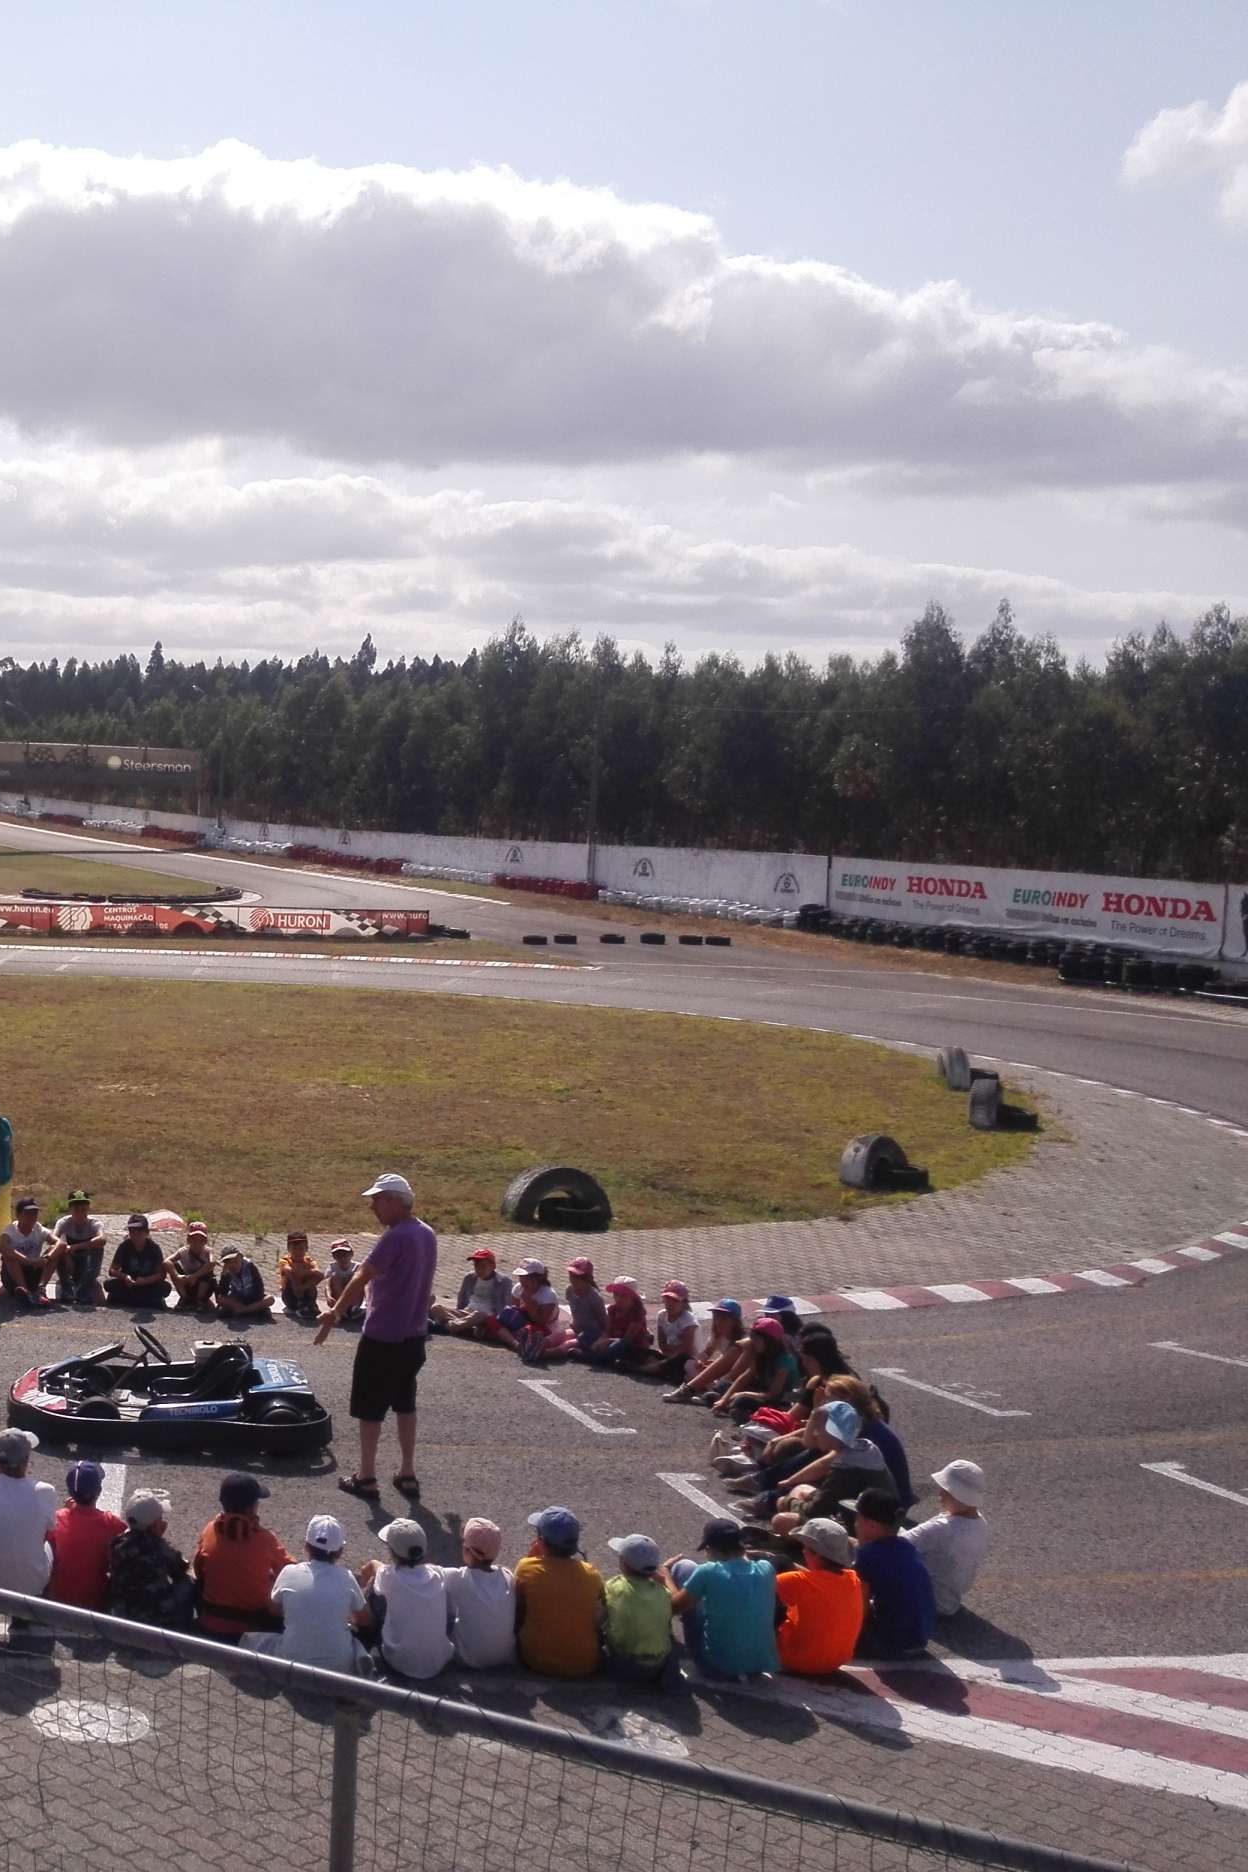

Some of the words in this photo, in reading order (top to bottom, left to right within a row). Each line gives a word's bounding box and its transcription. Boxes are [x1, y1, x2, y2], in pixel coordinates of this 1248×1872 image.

[123, 759, 192, 773] Steersman
[840, 873, 897, 891] EUROINDY
[906, 876, 988, 900] HONDA
[1012, 888, 1090, 909] EUROINDY
[1102, 892, 1217, 922] HONDA
[103, 906, 137, 914] CENTROS
[278, 914, 326, 928] HURON
[1111, 919, 1127, 932] The
[1129, 922, 1157, 935] Power
[1159, 927, 1167, 936] of
[1169, 926, 1207, 941] Dreams
